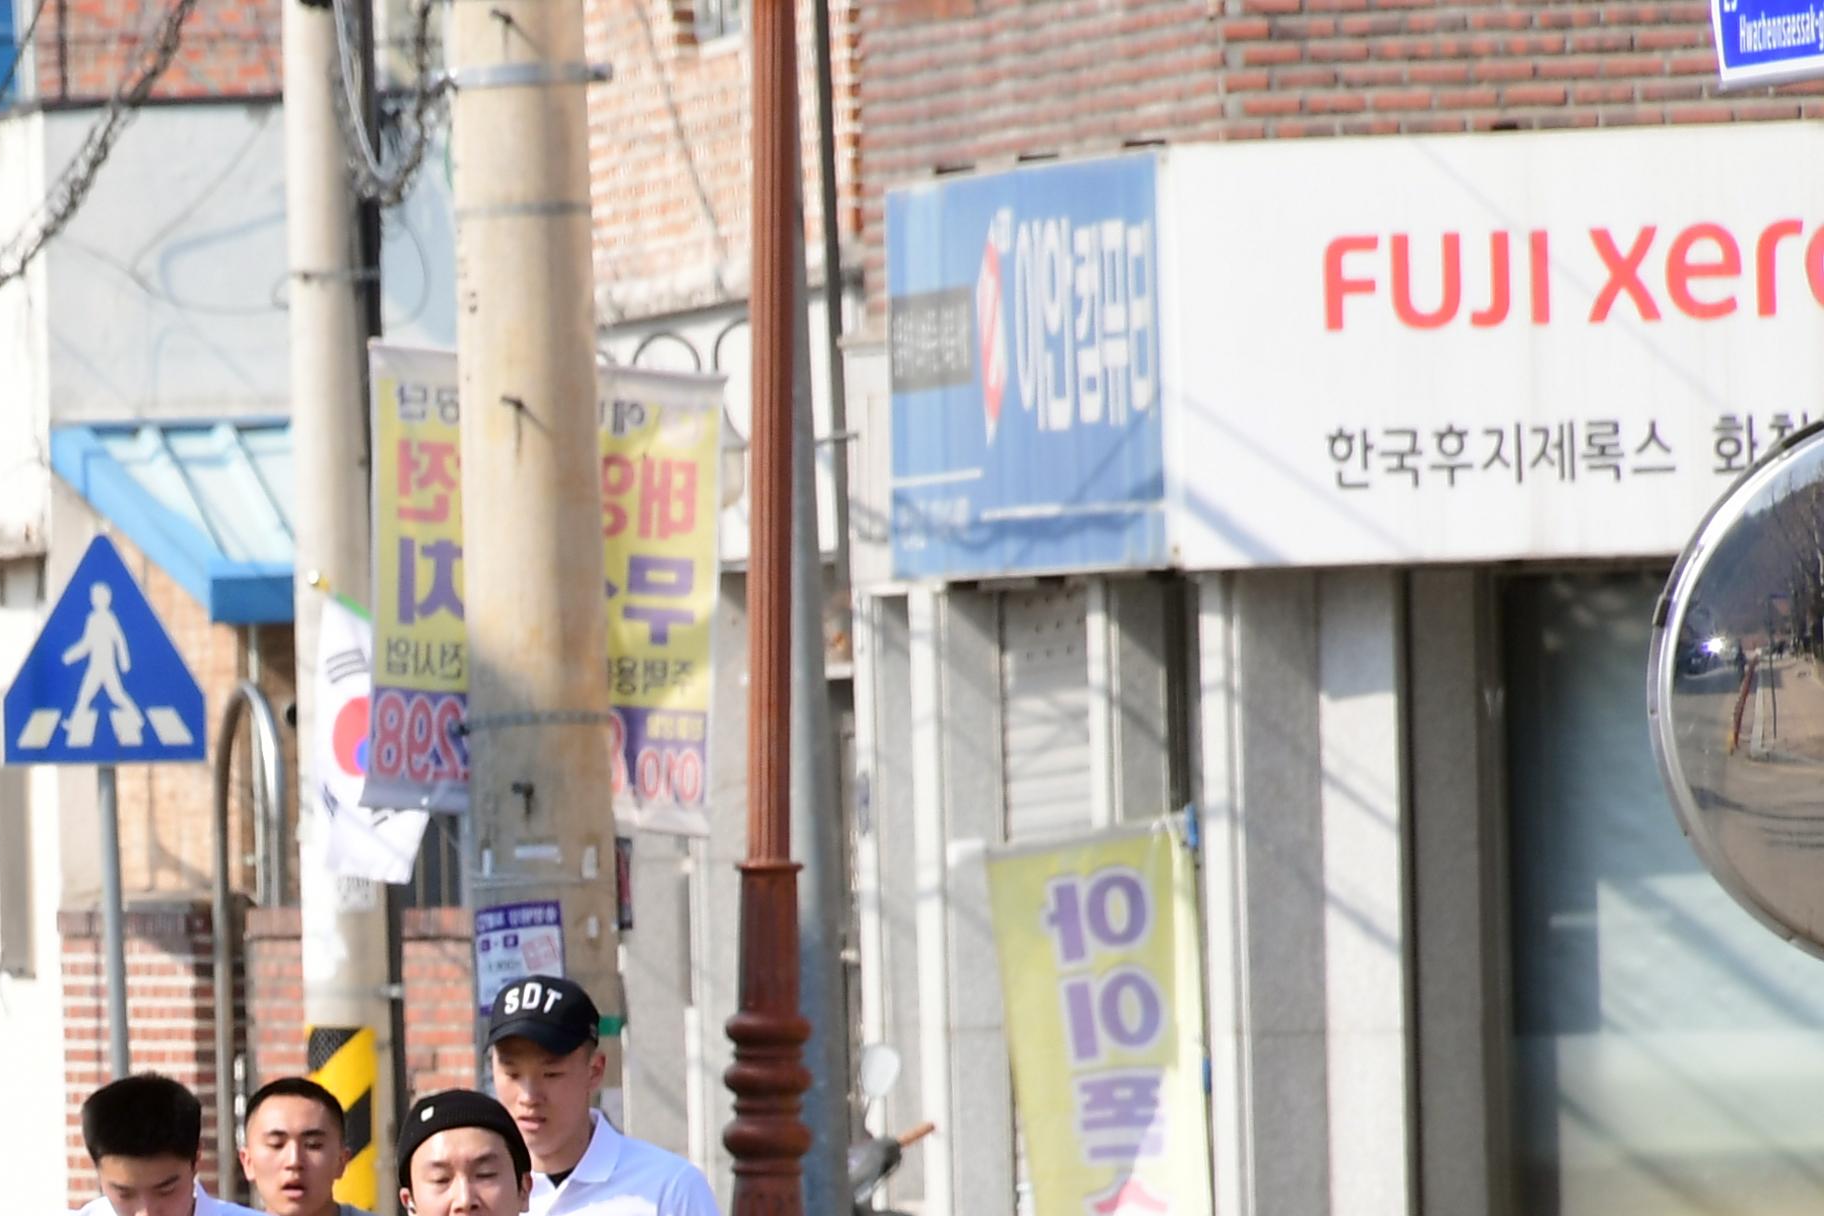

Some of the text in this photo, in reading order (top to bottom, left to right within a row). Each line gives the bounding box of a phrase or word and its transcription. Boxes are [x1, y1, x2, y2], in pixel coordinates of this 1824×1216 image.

[1014, 213, 1155, 432] 이안컴퓨터
[1322, 229, 1550, 331] FUJI
[1326, 418, 1677, 490] 한국후지제록스
[503, 981, 563, 1015] SDT
